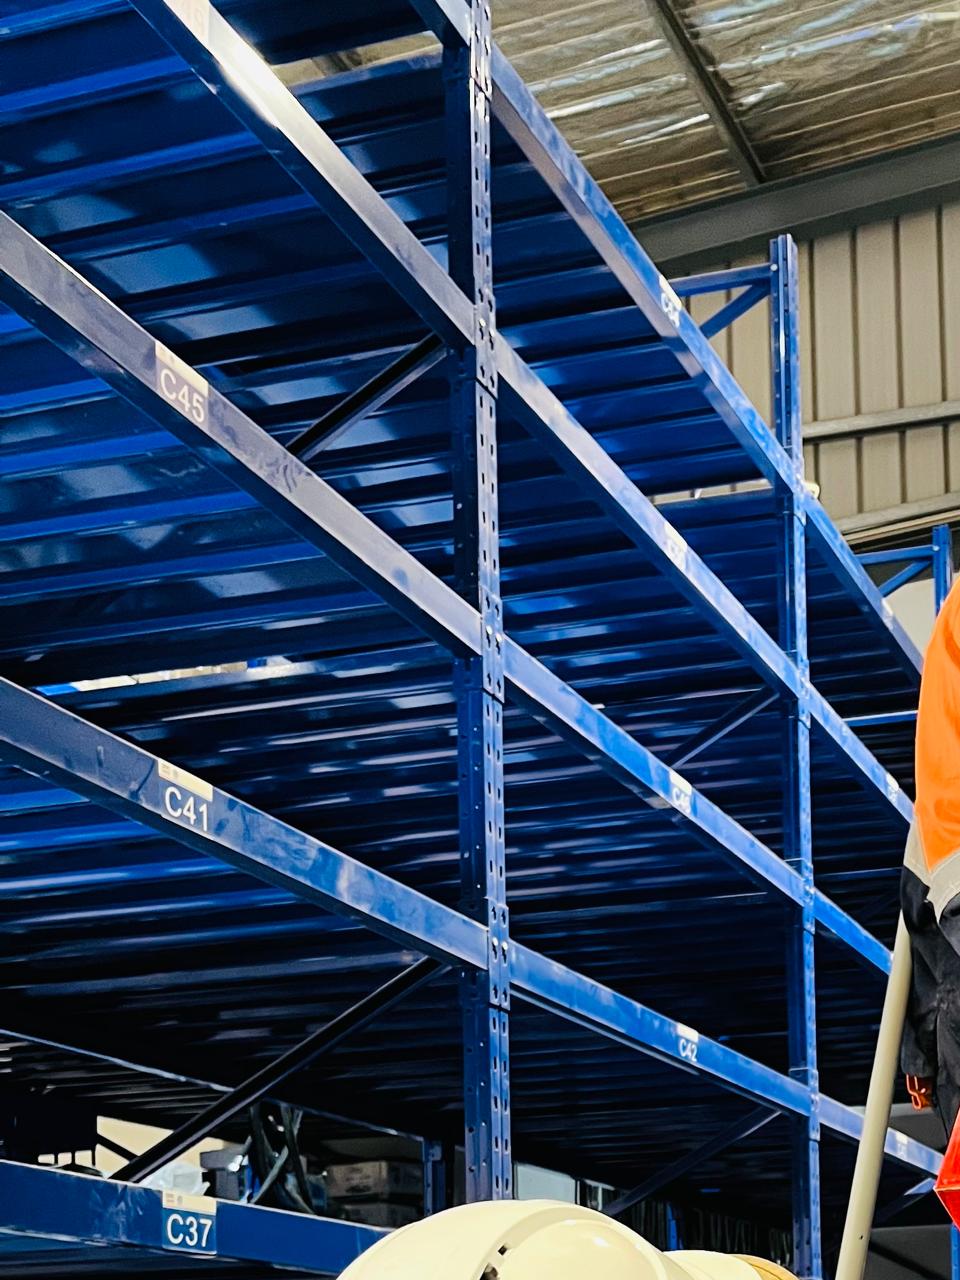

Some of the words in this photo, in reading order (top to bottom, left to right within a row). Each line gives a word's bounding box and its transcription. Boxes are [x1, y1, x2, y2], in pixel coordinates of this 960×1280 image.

[160, 367, 205, 422] C45
[165, 786, 209, 832] C41
[679, 1038, 698, 1062] C42
[167, 1213, 213, 1248] C37
